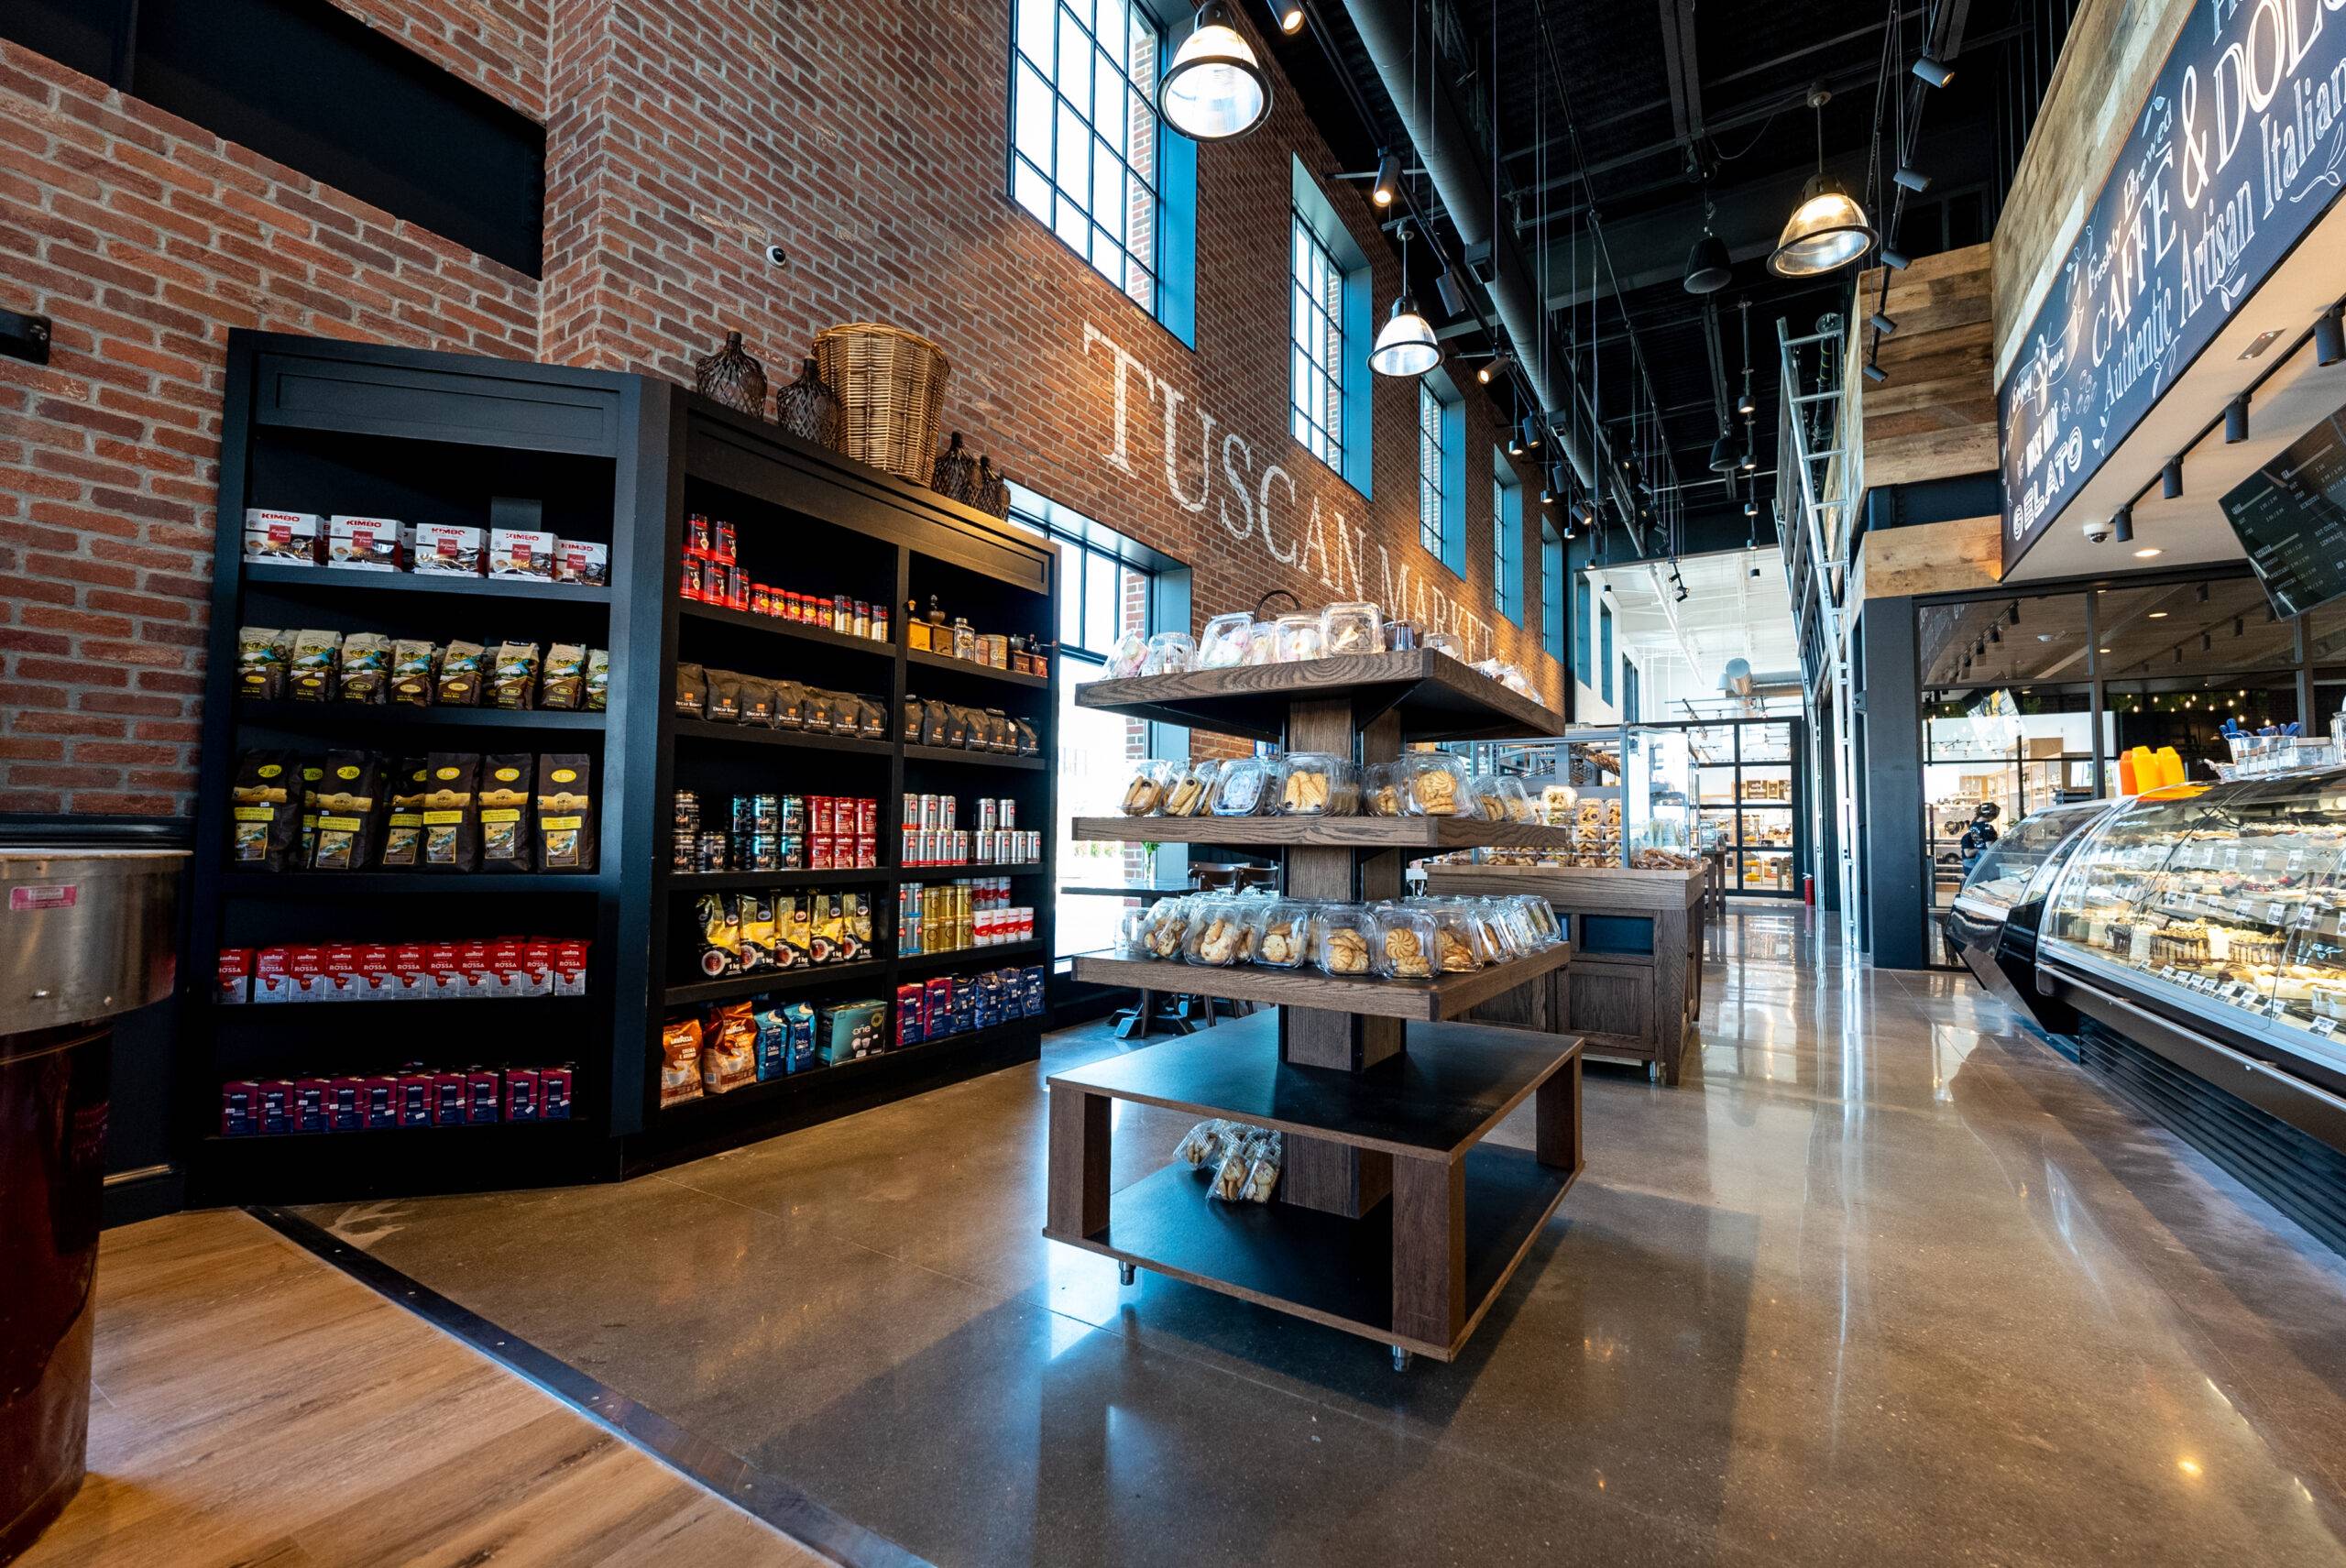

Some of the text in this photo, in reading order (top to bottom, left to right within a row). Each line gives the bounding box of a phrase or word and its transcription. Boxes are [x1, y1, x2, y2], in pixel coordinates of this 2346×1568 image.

[2182, 65, 2209, 209] &
[2088, 98, 2173, 300] Freshly Brewed
[2104, 57, 2346, 412] Authentic Artisan Italian
[1083, 323, 1494, 663] TUSCAN MARKET
[2013, 426, 2083, 542] GELATO
[261, 512, 301, 522] KIMBO
[346, 520, 382, 528] KIMBO
[260, 765, 280, 775] 2 lbs
[339, 767, 357, 776] 2 lbs
[851, 1025, 871, 1035] one
